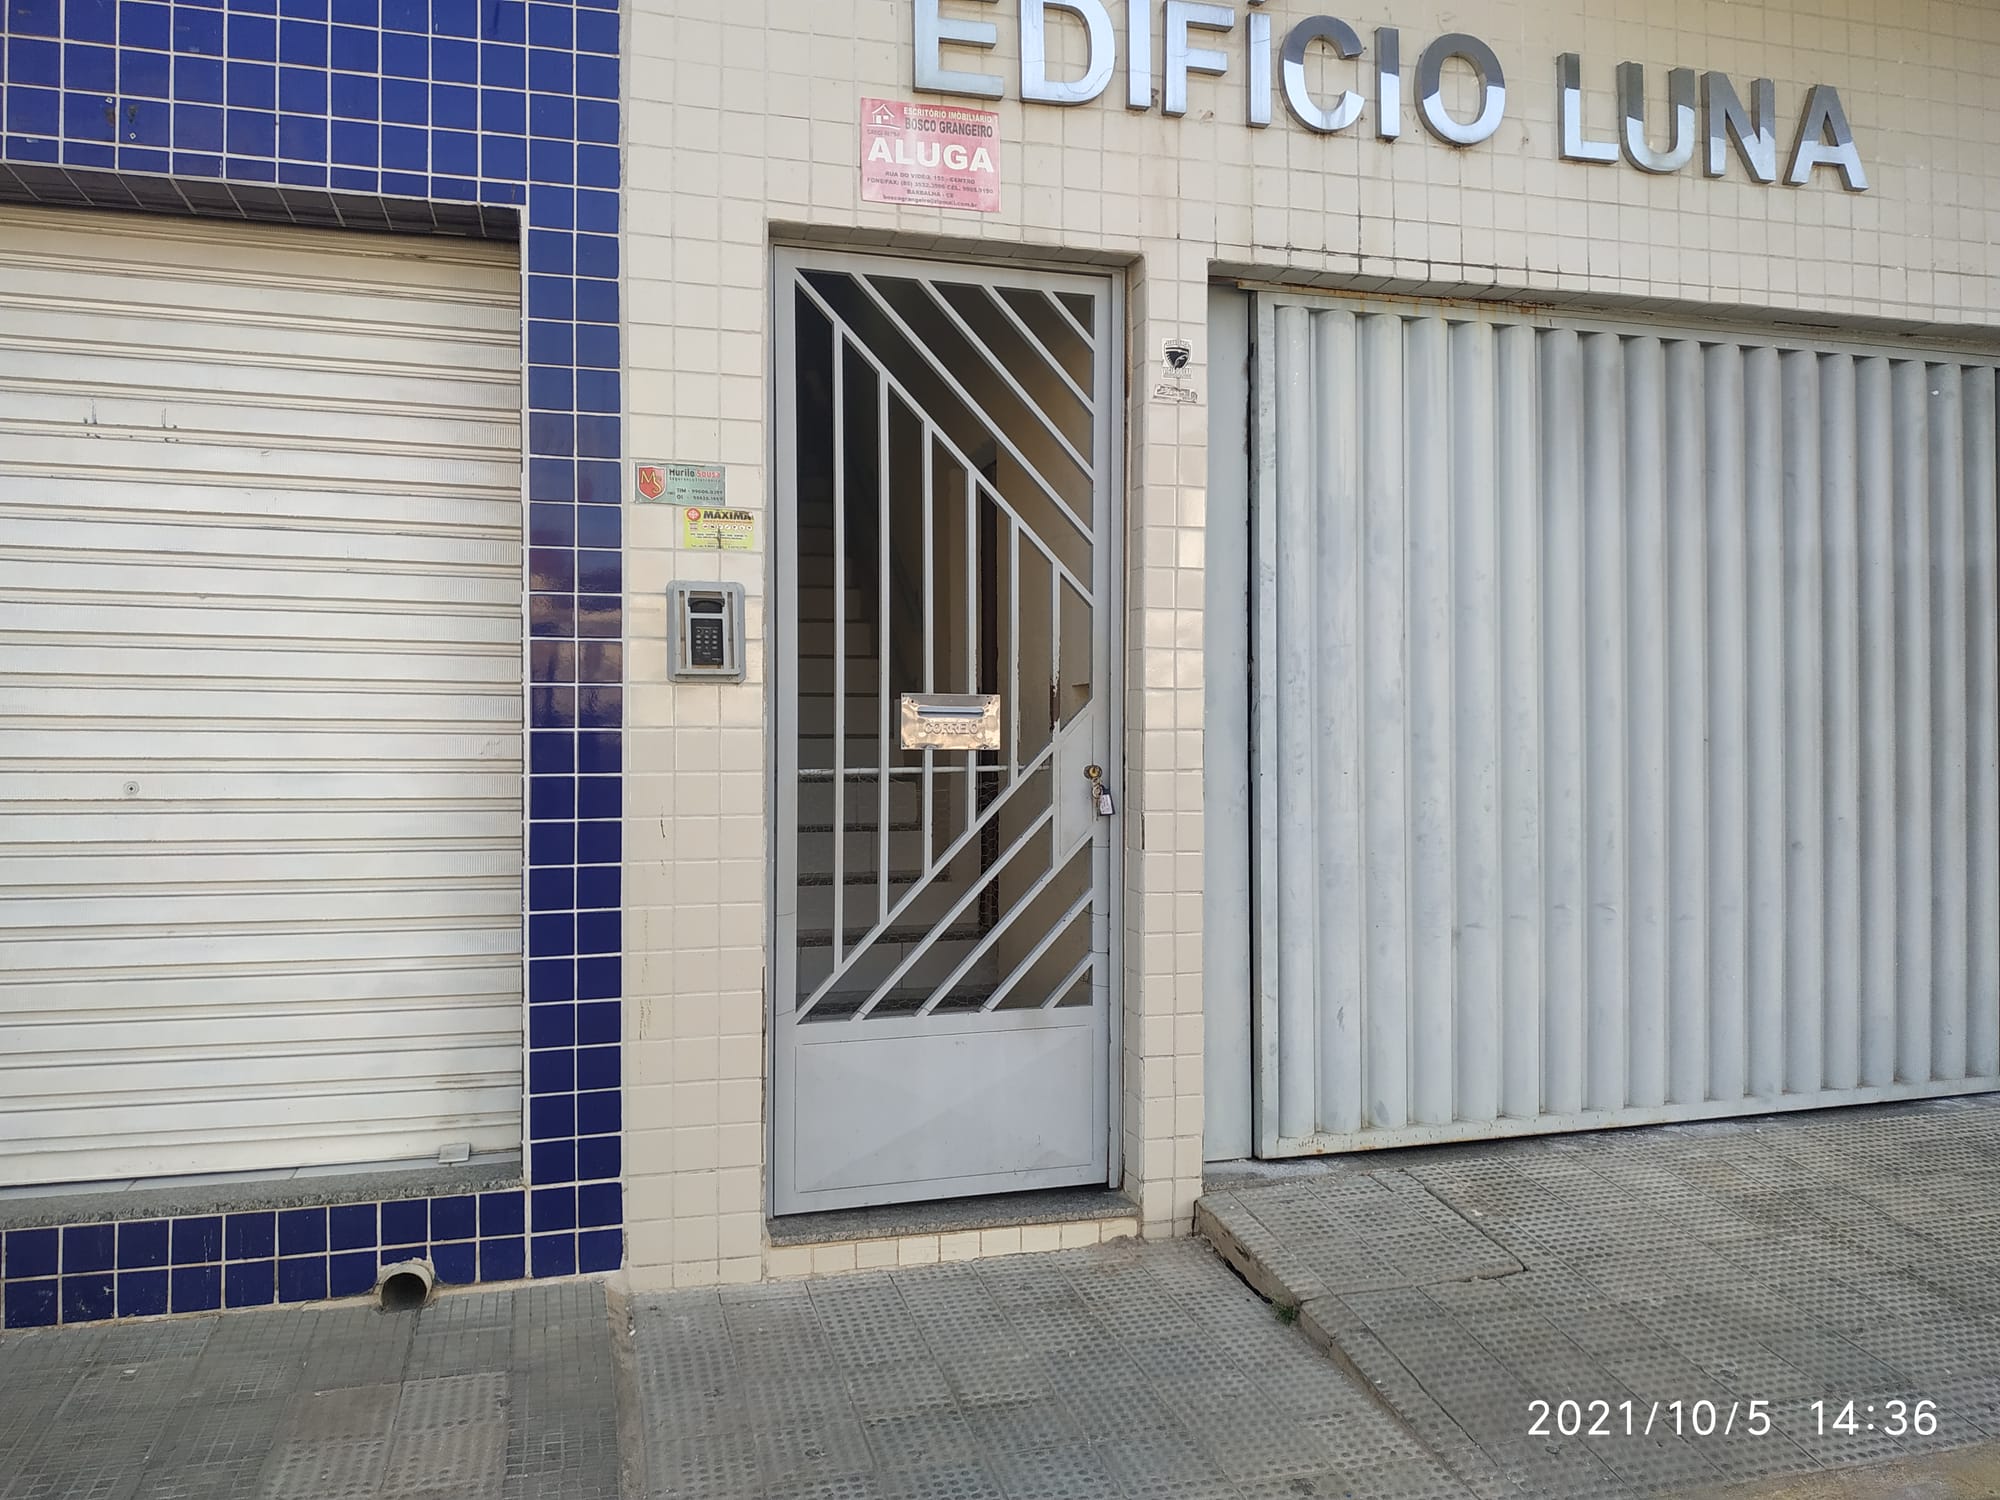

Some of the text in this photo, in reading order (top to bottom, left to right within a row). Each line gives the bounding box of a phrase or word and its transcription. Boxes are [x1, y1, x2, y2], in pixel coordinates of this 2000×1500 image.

[912, 0, 1869, 193] EDIFÍCIO LUNA
[903, 106, 993, 123] ESCRITÓRIO IMOBILIÁRIO
[905, 117, 993, 138] BOSCO GRANGEIRO
[868, 136, 994, 173] ALUGA
[950, 176, 976, 184] CENTRO
[669, 468, 721, 479] Murilo Sousa
